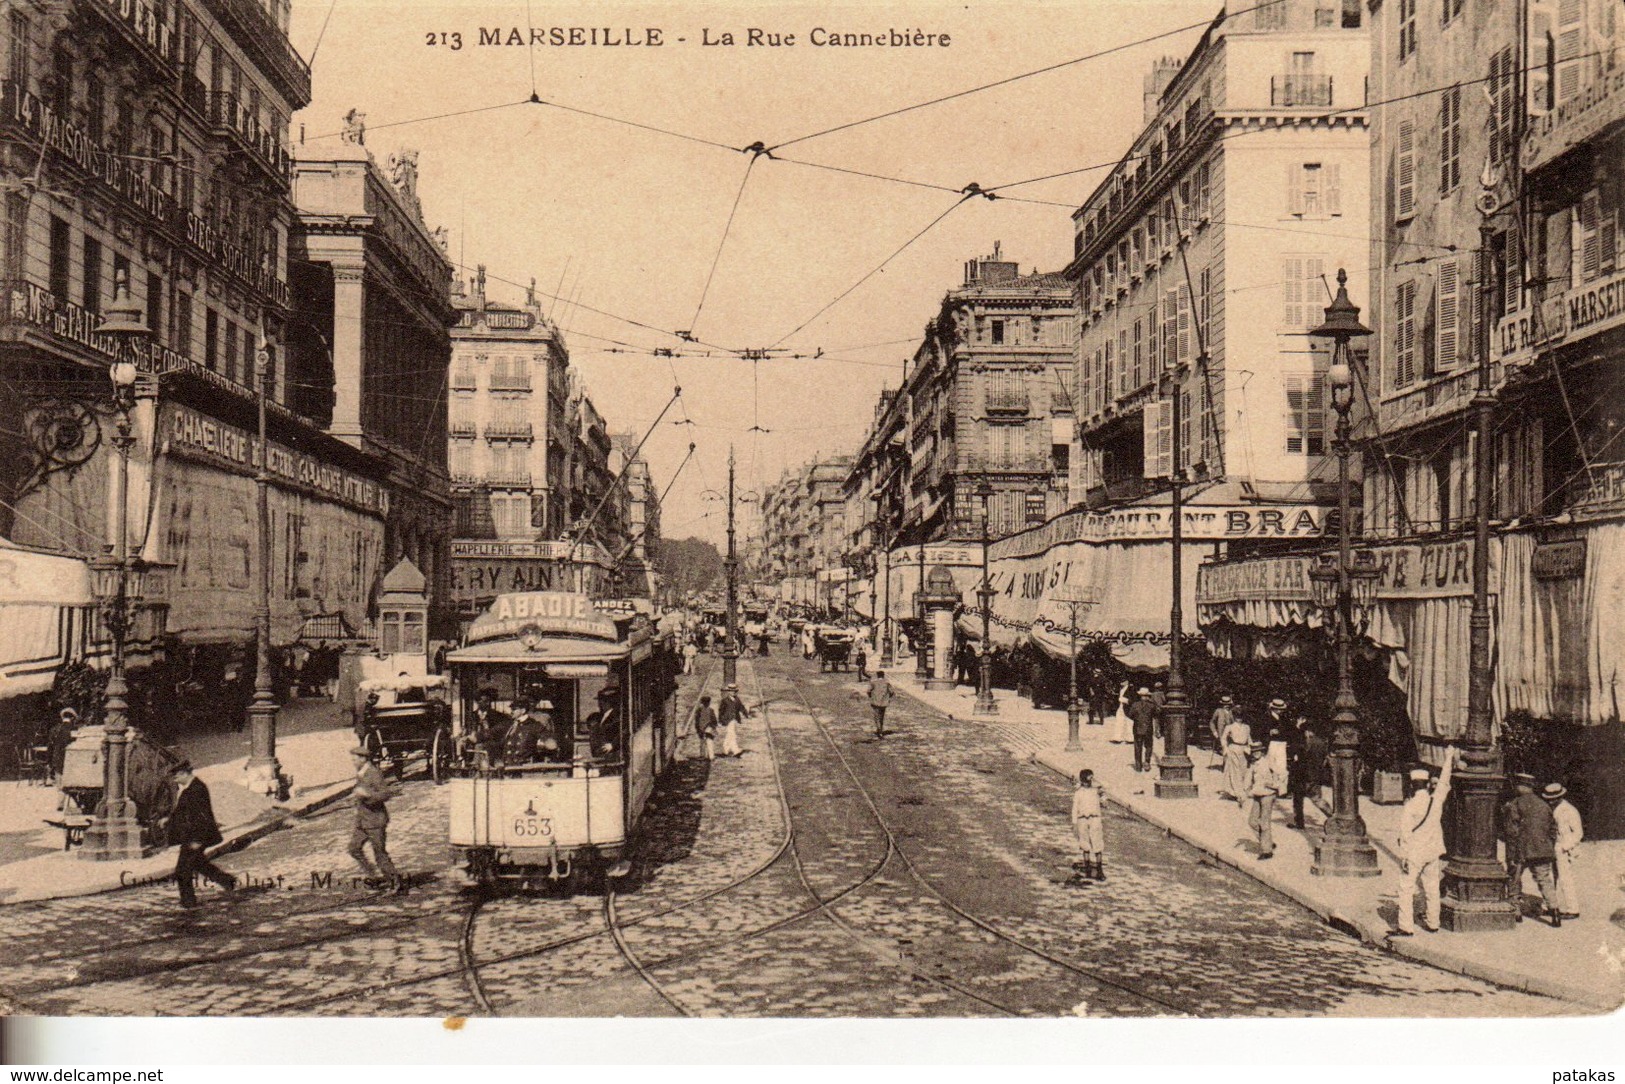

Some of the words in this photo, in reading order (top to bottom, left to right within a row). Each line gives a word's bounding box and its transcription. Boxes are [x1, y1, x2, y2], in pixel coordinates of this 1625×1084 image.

[14, 84, 32, 131] 14
[38, 97, 100, 177] MAISONS
[104, 152, 121, 190] DE
[125, 166, 164, 221] VENTE
[236, 101, 285, 173] HOTEL
[1500, 321, 1517, 358] LE
[499, 596, 587, 620] ABADIE
[514, 817, 552, 836] 653
